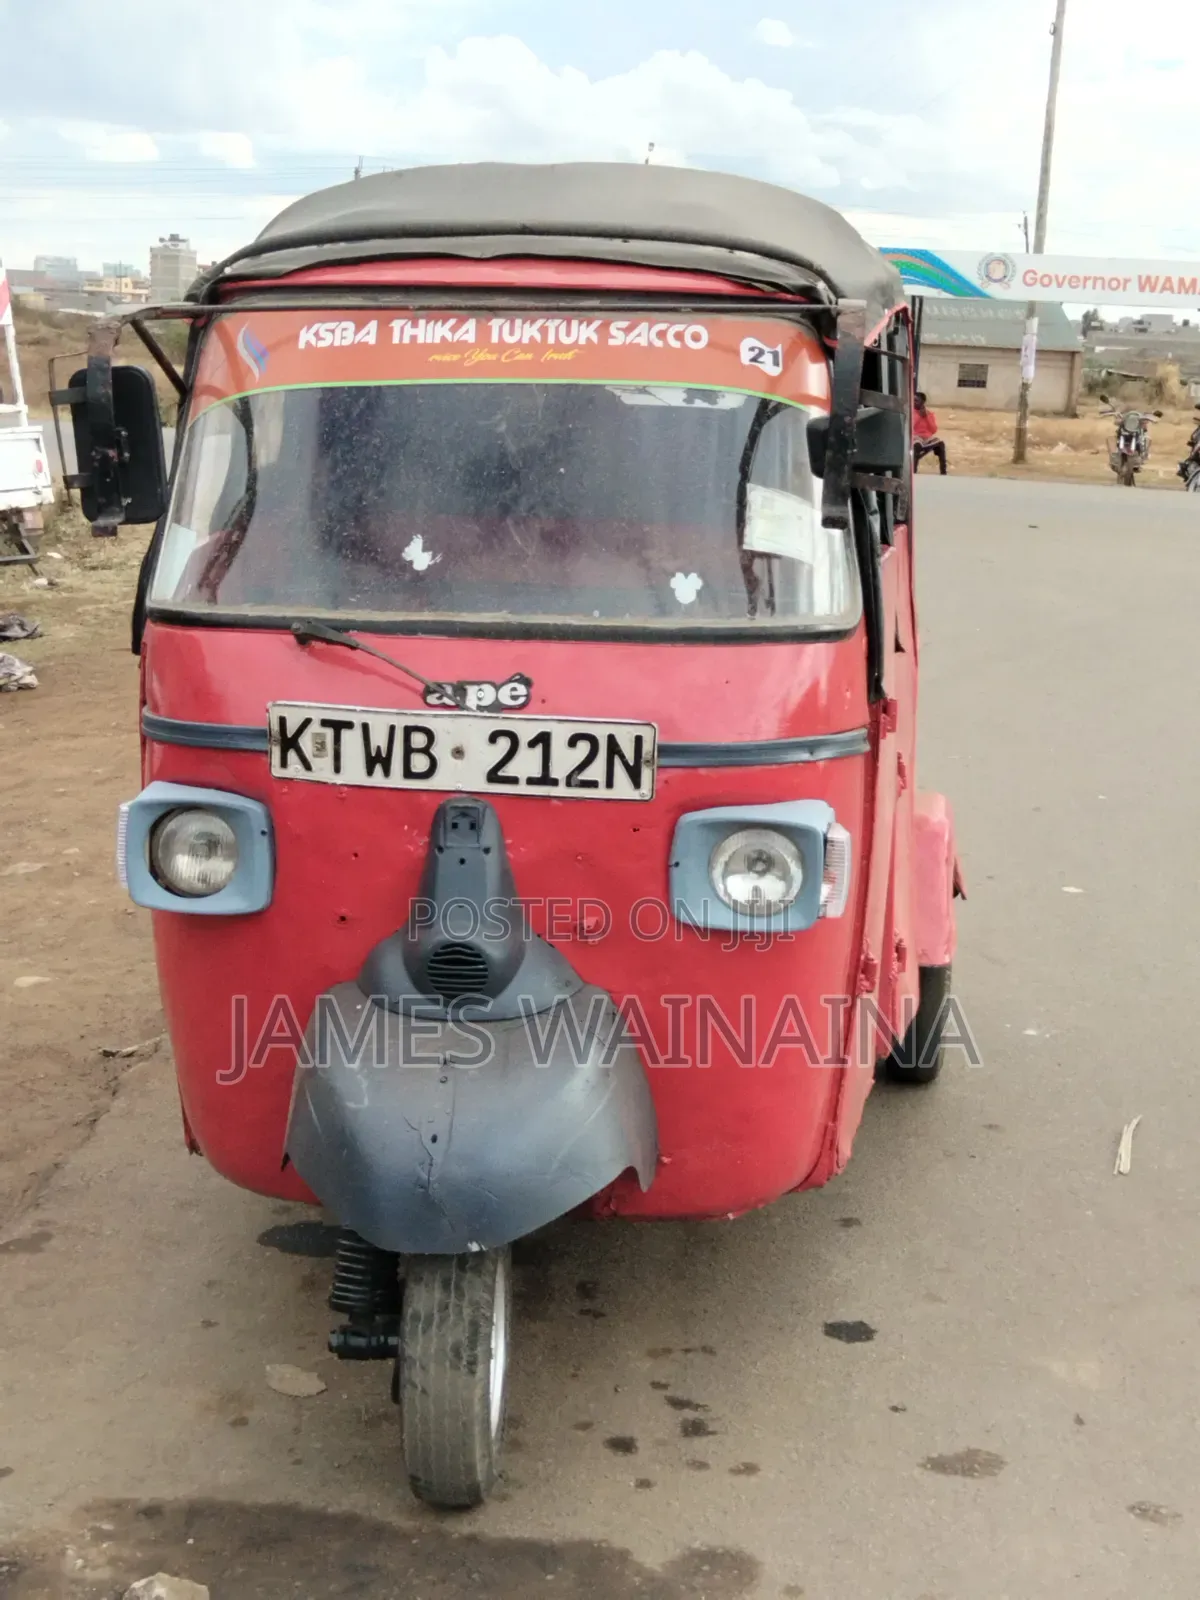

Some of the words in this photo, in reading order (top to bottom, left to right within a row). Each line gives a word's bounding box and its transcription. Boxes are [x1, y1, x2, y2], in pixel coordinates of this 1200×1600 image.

[1022, 269, 1132, 292] Governor
[1137, 274, 1200, 296] WAM
[298, 319, 379, 349] KSBA
[388, 318, 477, 345] THIKA
[487, 317, 603, 346] TUKTUK
[608, 320, 709, 350] SACCO
[464, 348, 500, 366] You
[501, 348, 534, 363] Can
[748, 345, 781, 368] 21
[278, 716, 438, 780] KTWB
[486, 729, 644, 790] 212N
